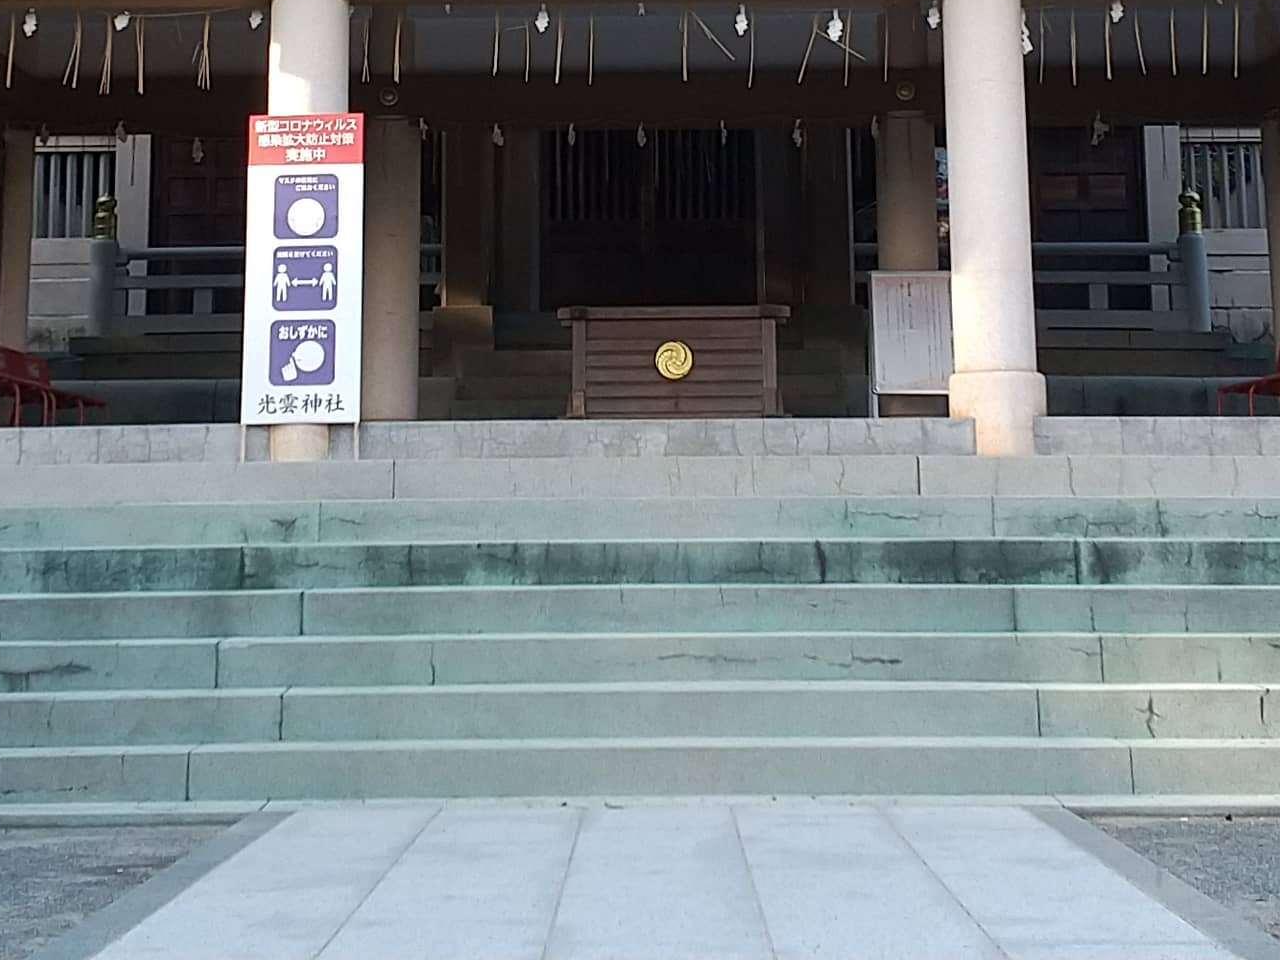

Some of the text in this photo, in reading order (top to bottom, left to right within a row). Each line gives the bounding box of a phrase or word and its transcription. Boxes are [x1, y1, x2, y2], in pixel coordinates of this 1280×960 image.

[255, 119, 357, 133] 新型コロナウィルス
[258, 132, 354, 147] 感染拡大防止対策
[285, 147, 326, 162] 実施中
[279, 325, 328, 340] おしずかに
[258, 393, 345, 415] 光雲神社
